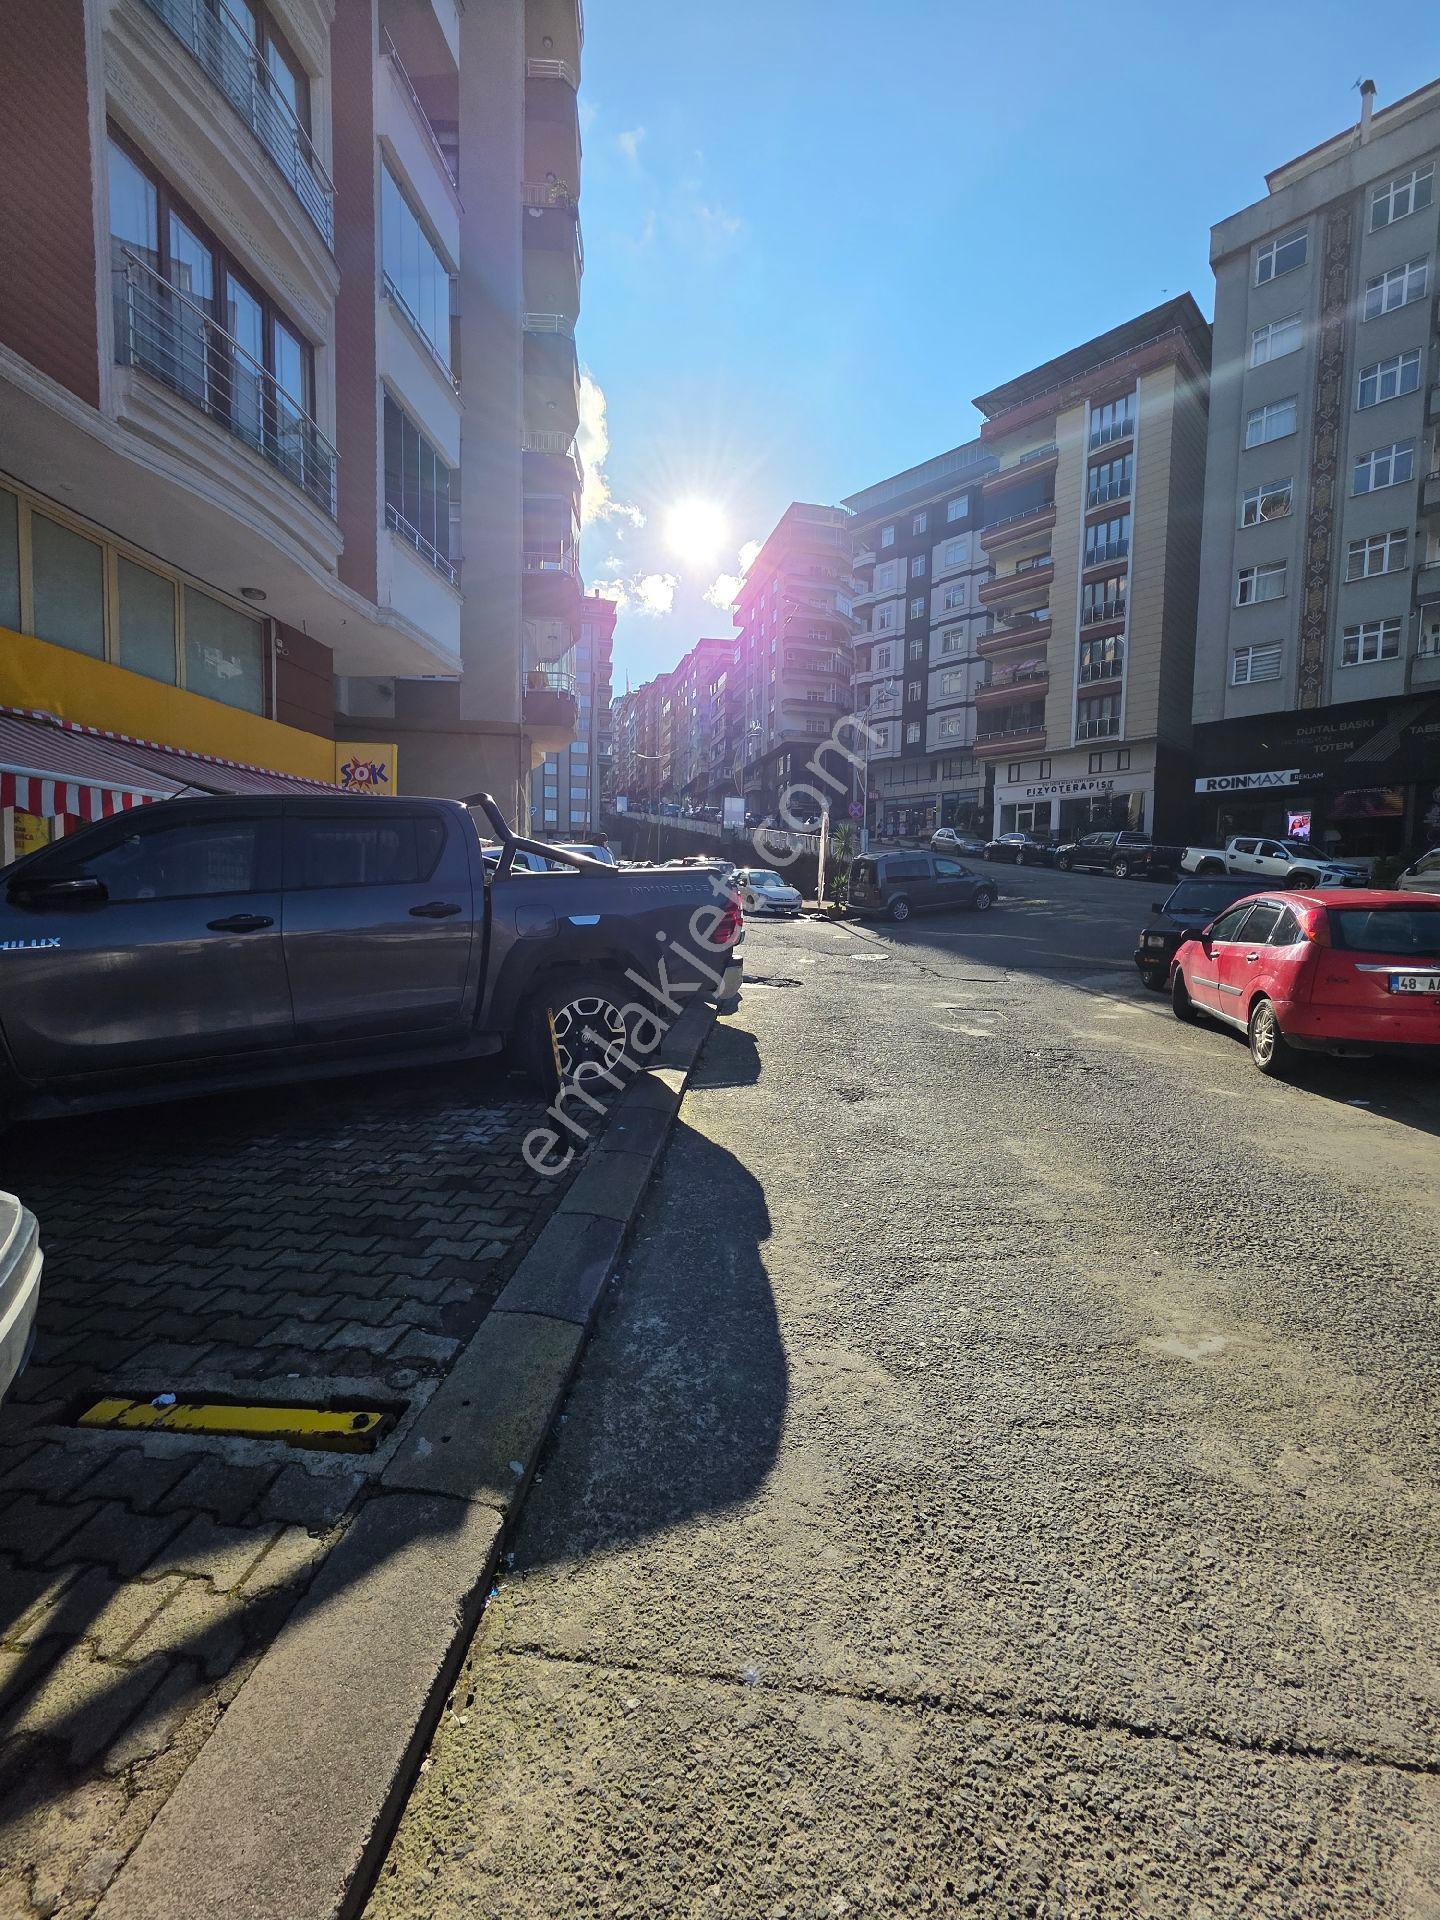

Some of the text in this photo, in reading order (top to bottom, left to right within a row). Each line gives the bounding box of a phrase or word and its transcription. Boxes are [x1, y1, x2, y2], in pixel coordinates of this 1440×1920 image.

[1313, 741, 1354, 752] TOTEM
[1206, 773, 1286, 791] ROINMAX
[1294, 772, 1324, 781] REKLAM
[1400, 977, 1417, 990] 48
